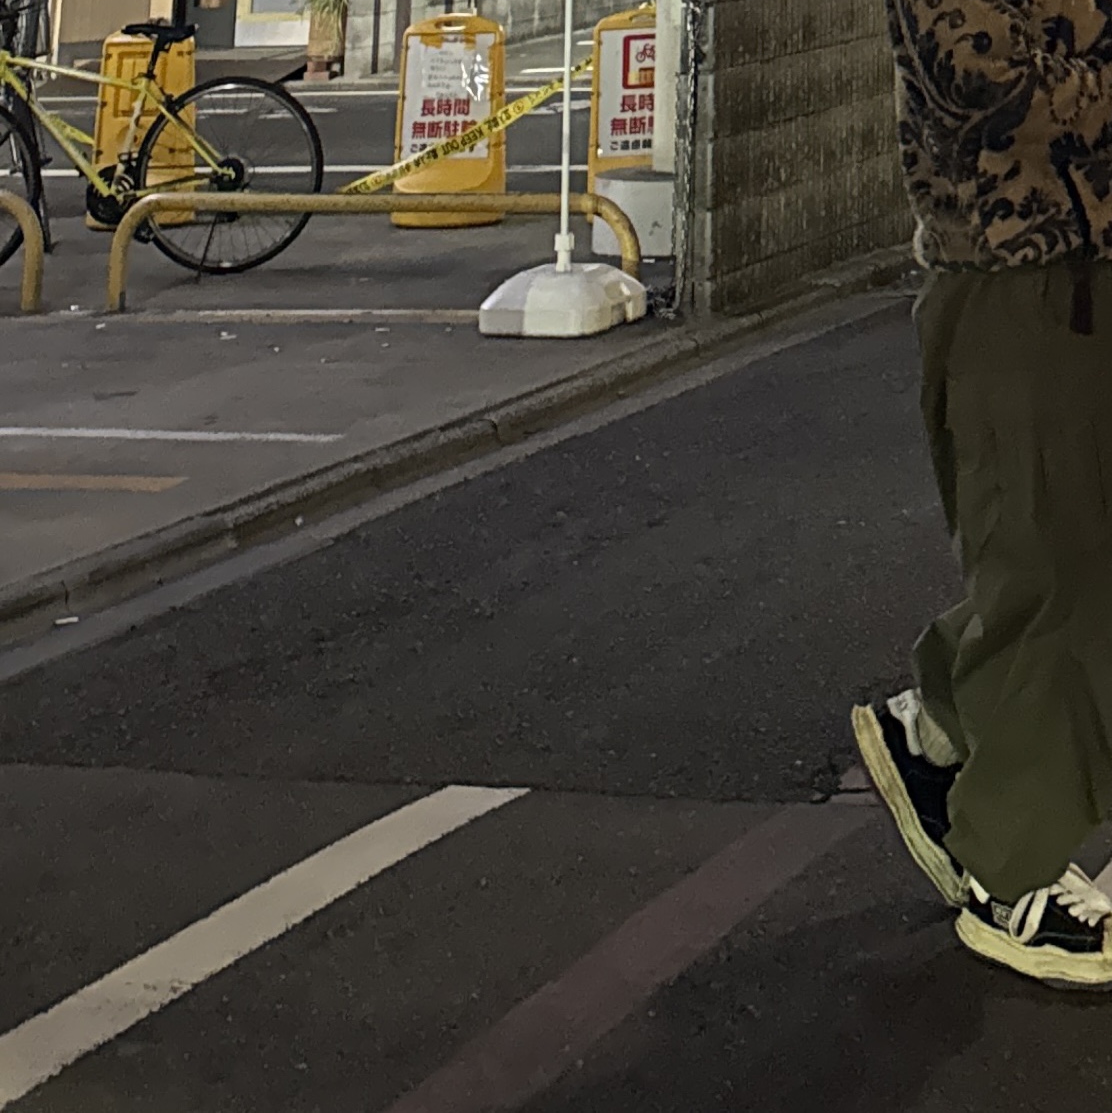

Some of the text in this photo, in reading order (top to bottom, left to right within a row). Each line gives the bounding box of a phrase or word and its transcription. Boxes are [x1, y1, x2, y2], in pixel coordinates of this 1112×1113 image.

[421, 98, 470, 117] 長時間
[461, 126, 485, 147] KEEP
[441, 139, 460, 156] OUT
